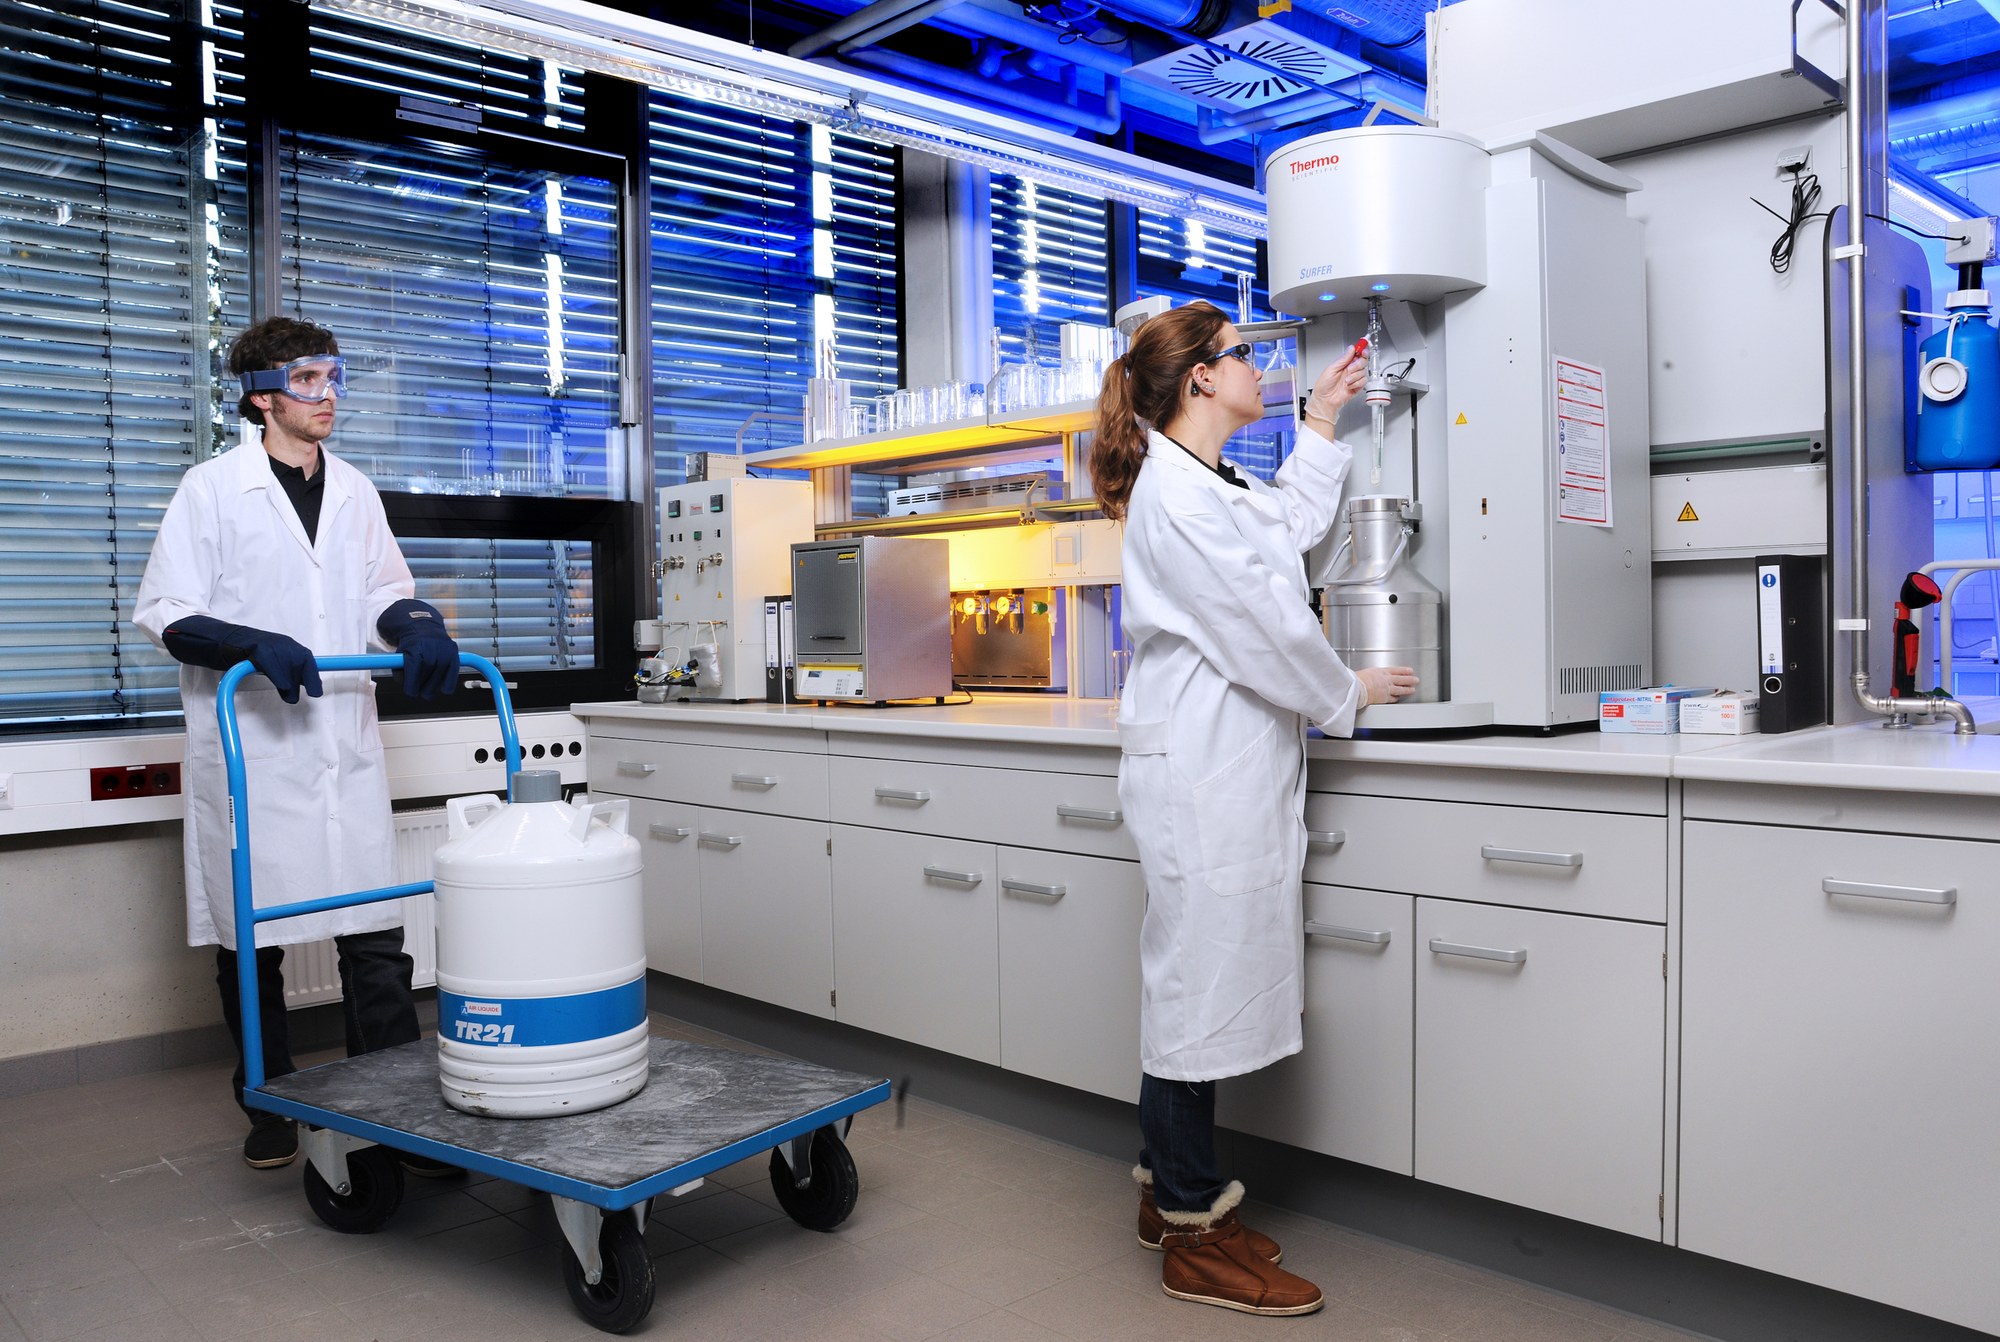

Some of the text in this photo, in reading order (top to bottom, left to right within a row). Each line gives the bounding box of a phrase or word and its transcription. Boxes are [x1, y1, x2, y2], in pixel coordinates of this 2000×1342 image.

[1290, 155, 1340, 175] Thermo
[1292, 165, 1338, 181] SCIENTIFIC
[1300, 264, 1333, 280] SURFER
[455, 1020, 515, 1043] TR21
